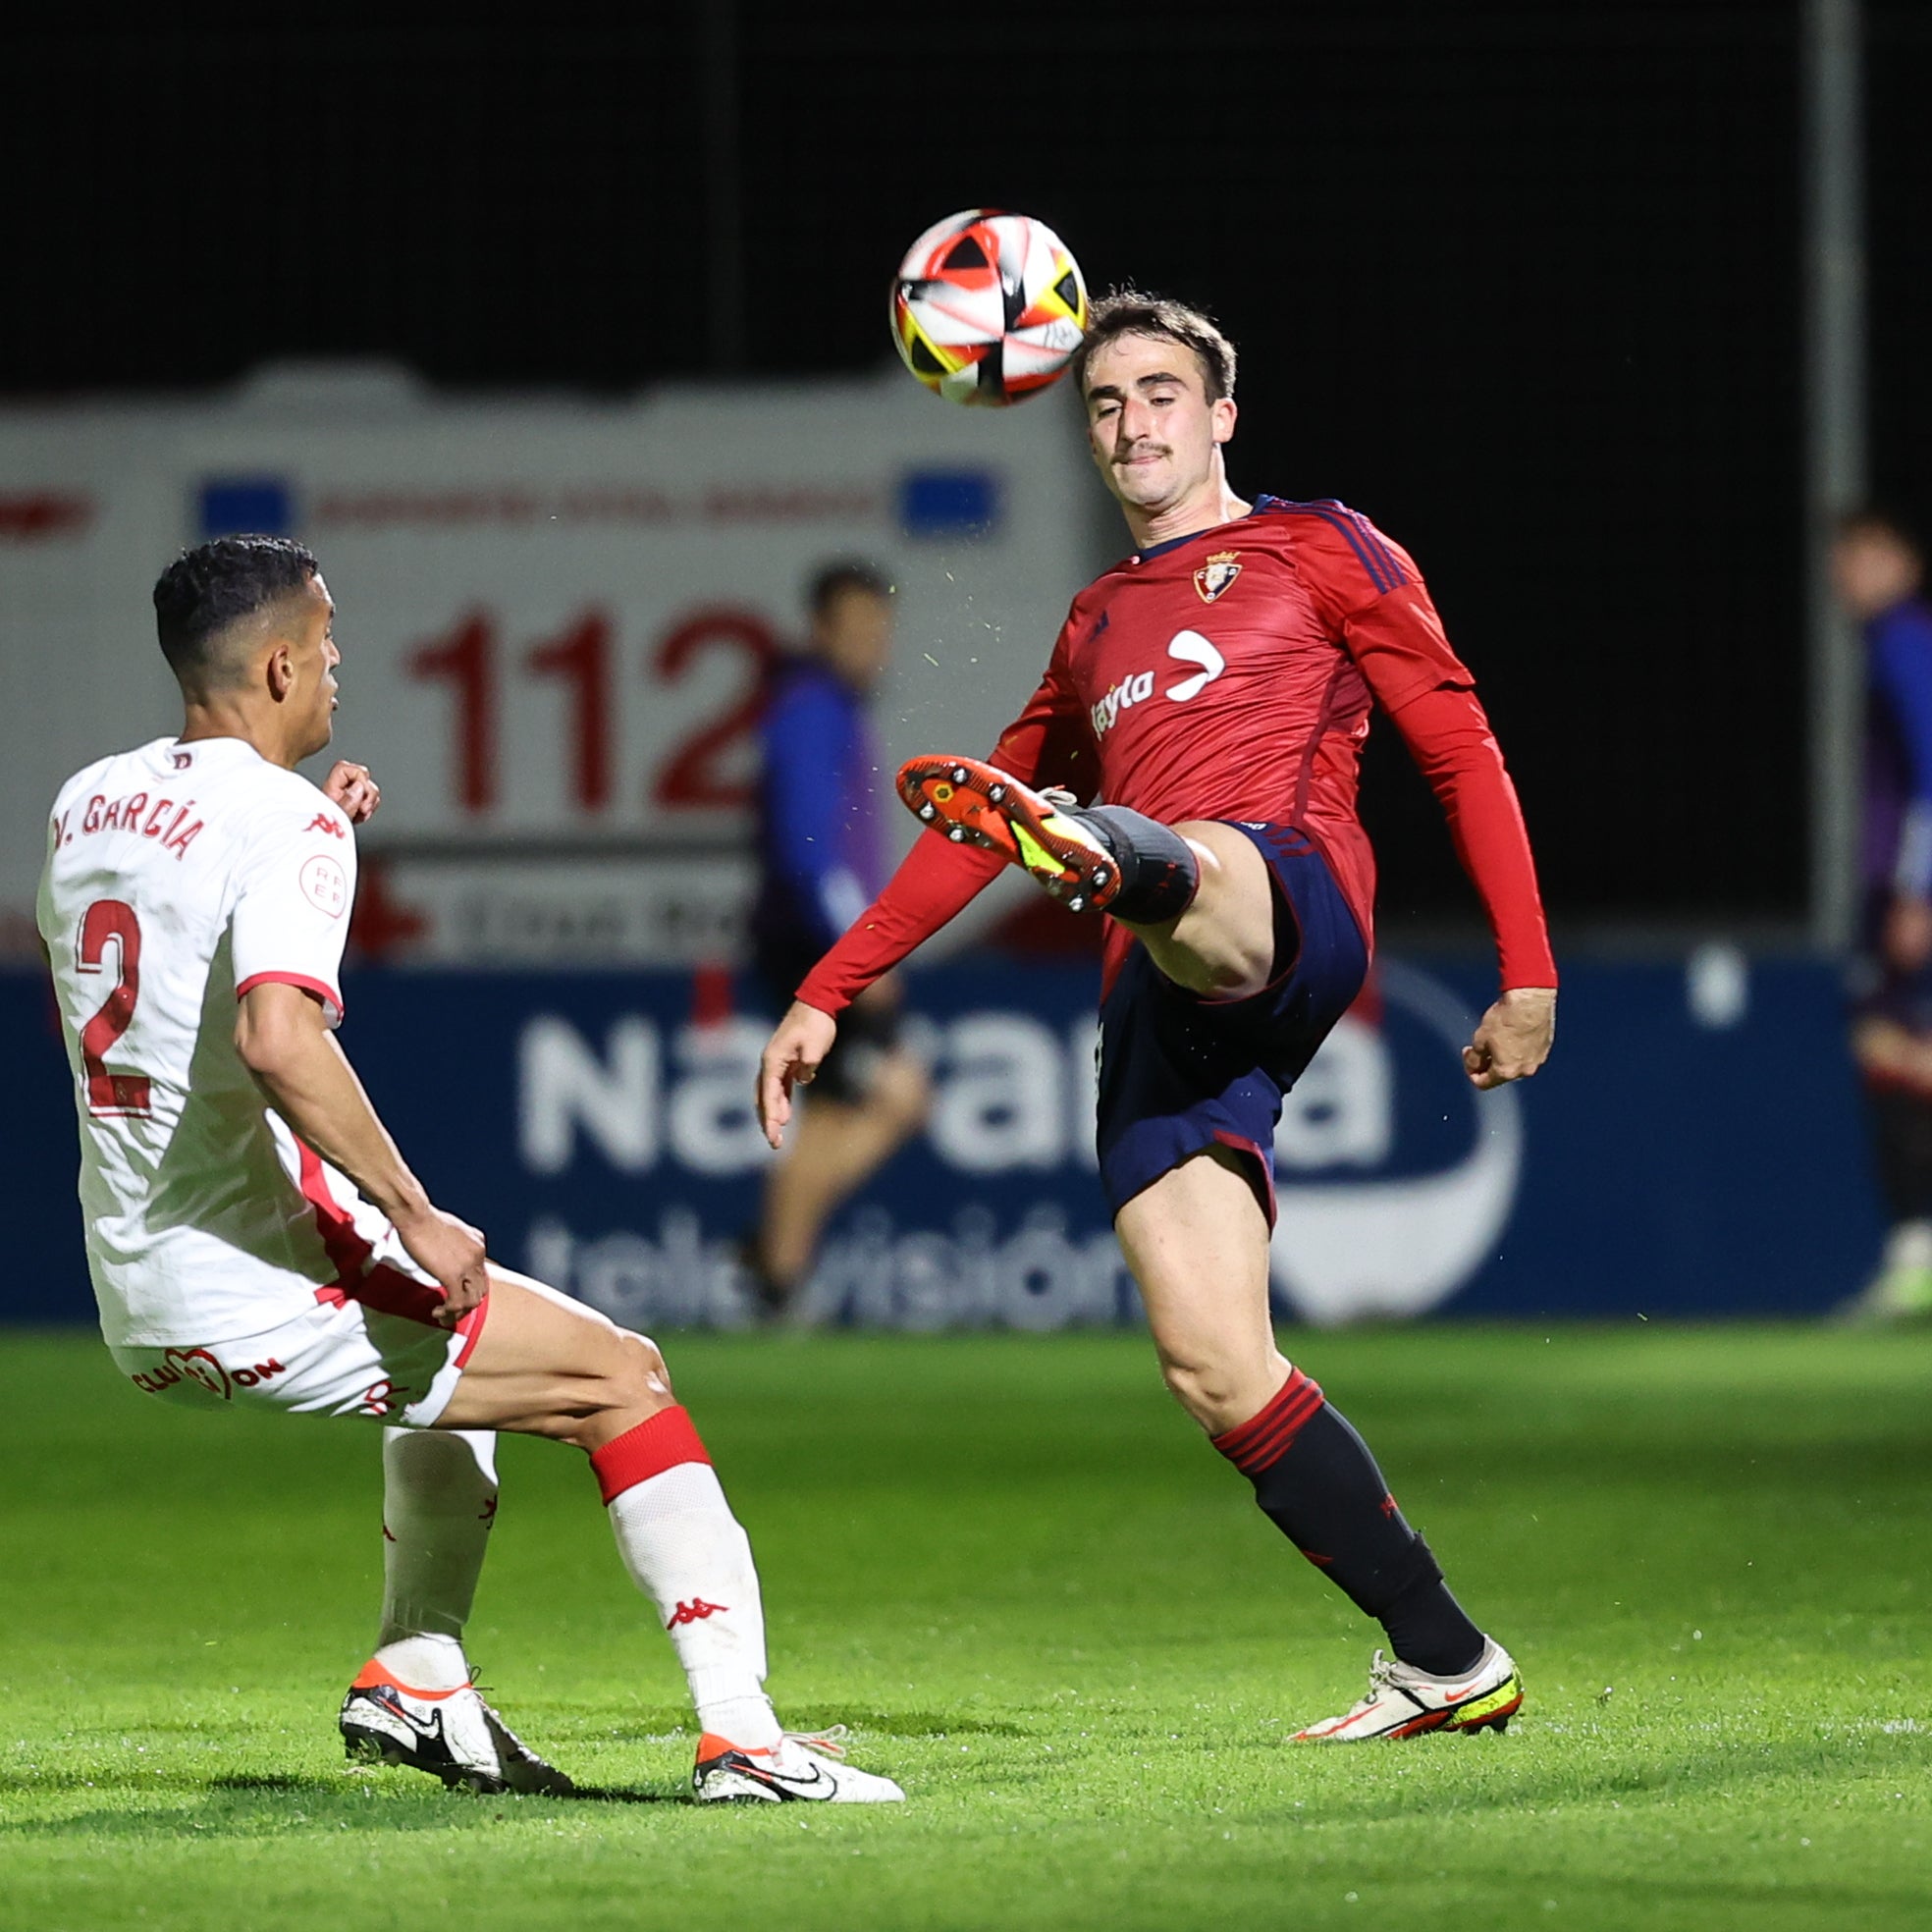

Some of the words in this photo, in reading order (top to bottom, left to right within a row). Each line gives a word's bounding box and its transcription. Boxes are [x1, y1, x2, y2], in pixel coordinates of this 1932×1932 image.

[409, 605, 780, 812] 112
[80, 791, 205, 862] GARCÍA
[76, 898, 152, 1119] 2
